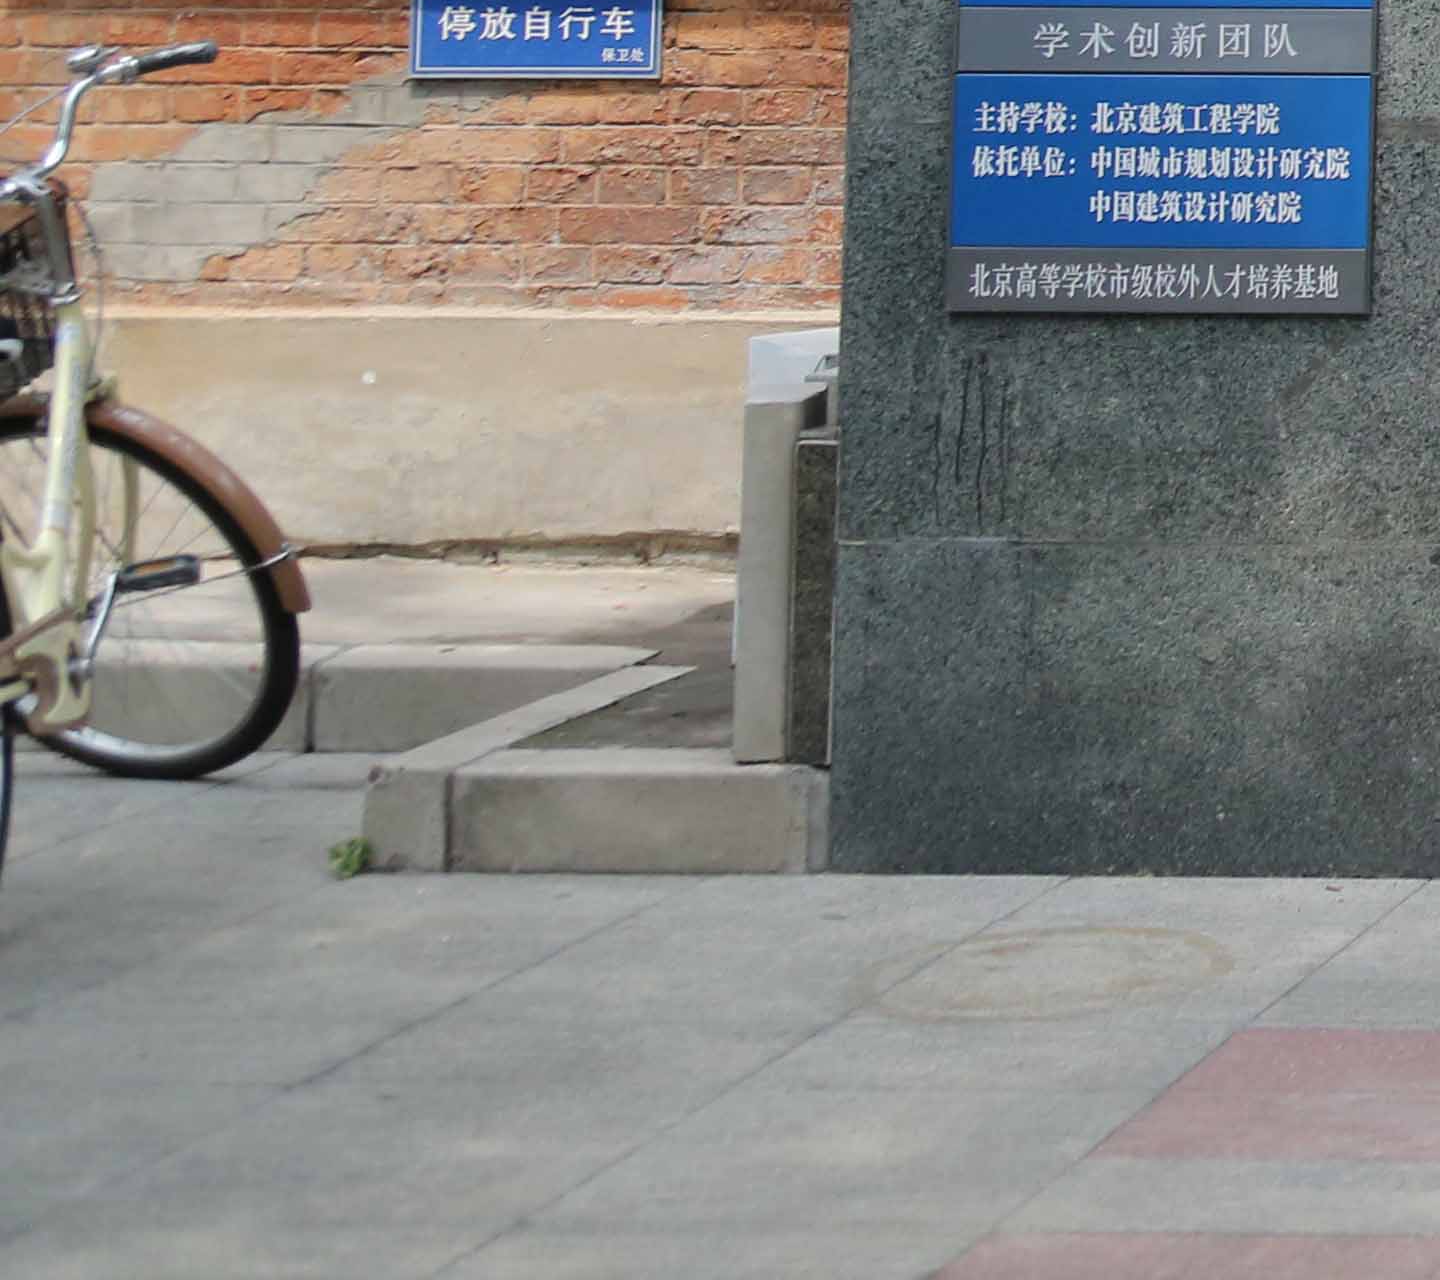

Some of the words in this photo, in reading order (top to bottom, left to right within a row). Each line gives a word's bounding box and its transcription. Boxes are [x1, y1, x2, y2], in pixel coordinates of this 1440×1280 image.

[437, 5, 636, 41] 停放自行车
[1032, 21, 1298, 59] 学术创新团队
[601, 47, 645, 64] 保卫处
[1089, 190, 1302, 224] 中国建筑设计研究院
[968, 262, 1340, 300] 北京高等学校市级校外人才培养基地
